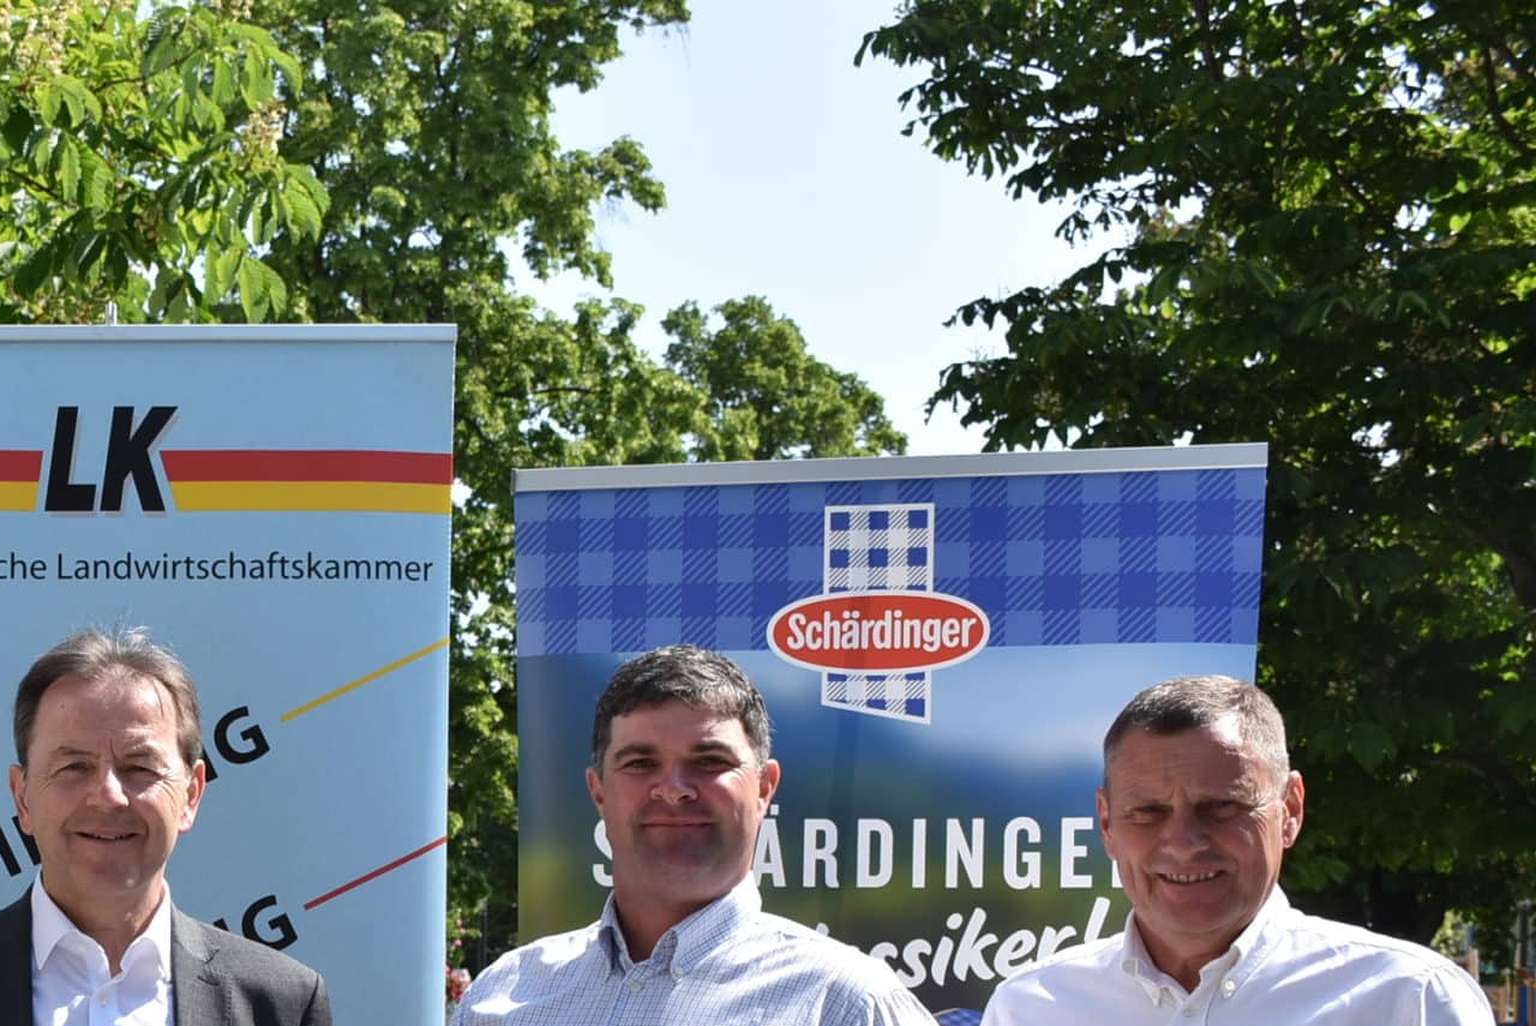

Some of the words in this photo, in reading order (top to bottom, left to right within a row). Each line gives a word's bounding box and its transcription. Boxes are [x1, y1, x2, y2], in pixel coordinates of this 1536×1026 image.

[43, 405, 178, 513] LK
[57, 551, 433, 582] Landwirtschaftskammer
[786, 609, 977, 652] Schärdinger
[592, 804, 1124, 890] SÄRDINGE
